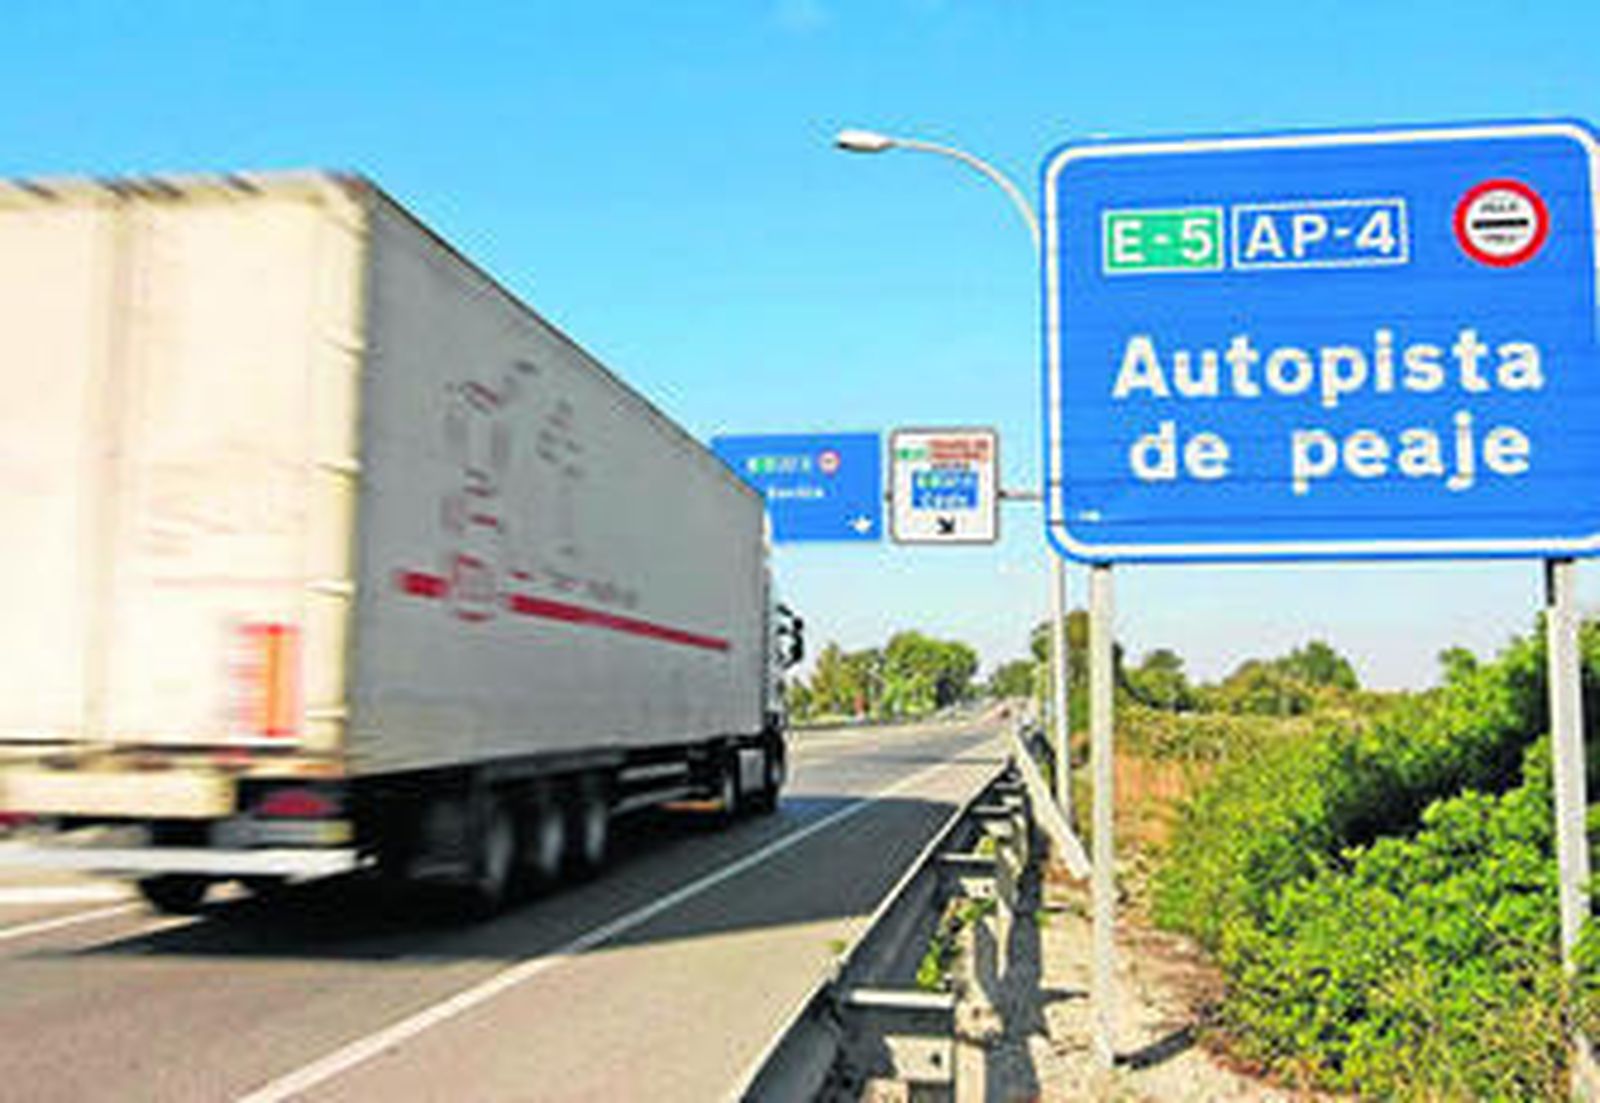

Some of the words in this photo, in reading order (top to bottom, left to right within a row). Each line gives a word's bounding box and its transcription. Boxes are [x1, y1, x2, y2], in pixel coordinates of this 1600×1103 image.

[1112, 217, 1213, 263] E-5
[1244, 211, 1396, 260] AP-4
[1111, 328, 1546, 408] Autopista
[1129, 420, 1231, 481] de
[1291, 410, 1531, 494] peaje
